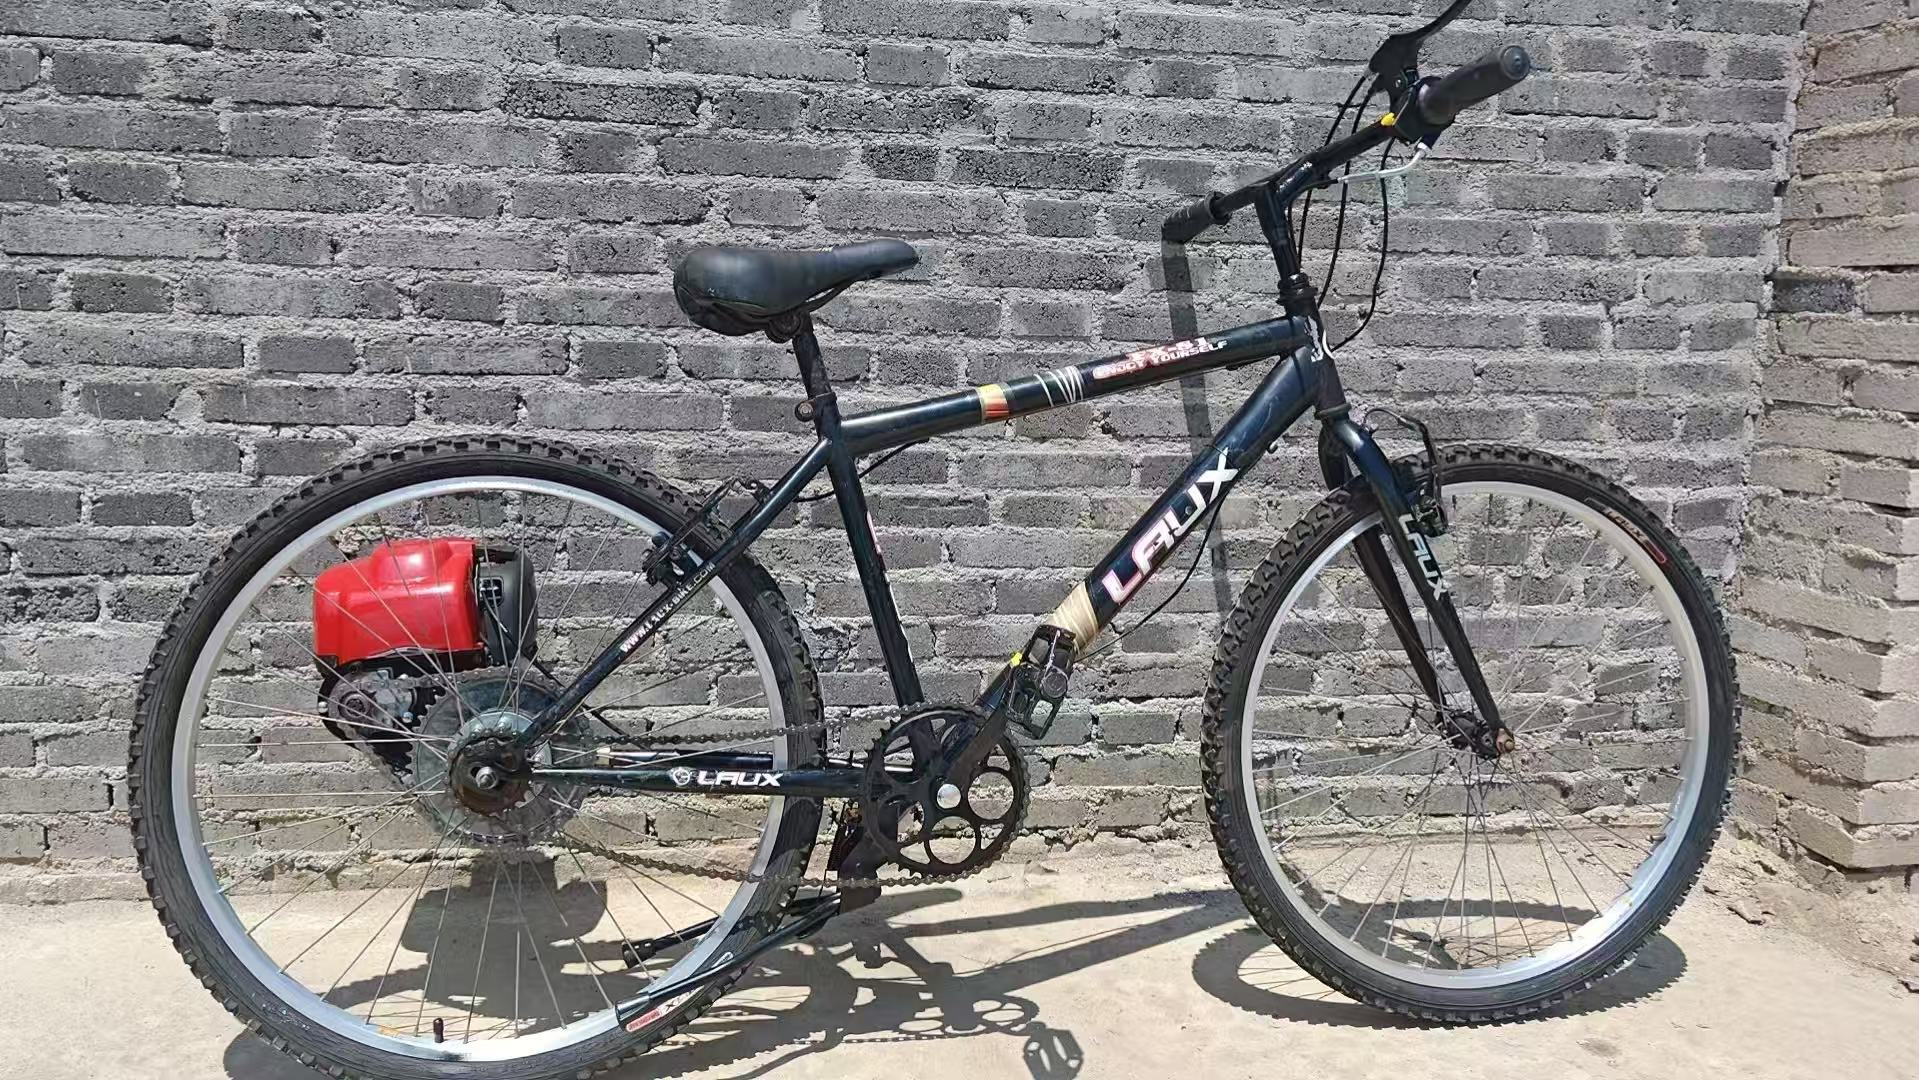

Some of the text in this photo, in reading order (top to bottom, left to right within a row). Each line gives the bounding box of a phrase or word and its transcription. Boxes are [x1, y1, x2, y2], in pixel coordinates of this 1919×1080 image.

[1150, 340, 1227, 365] YOURSELF
[1102, 447, 1239, 604] LAUX
[1398, 513, 1447, 601] LAUX
[697, 770, 783, 787] LAUX
